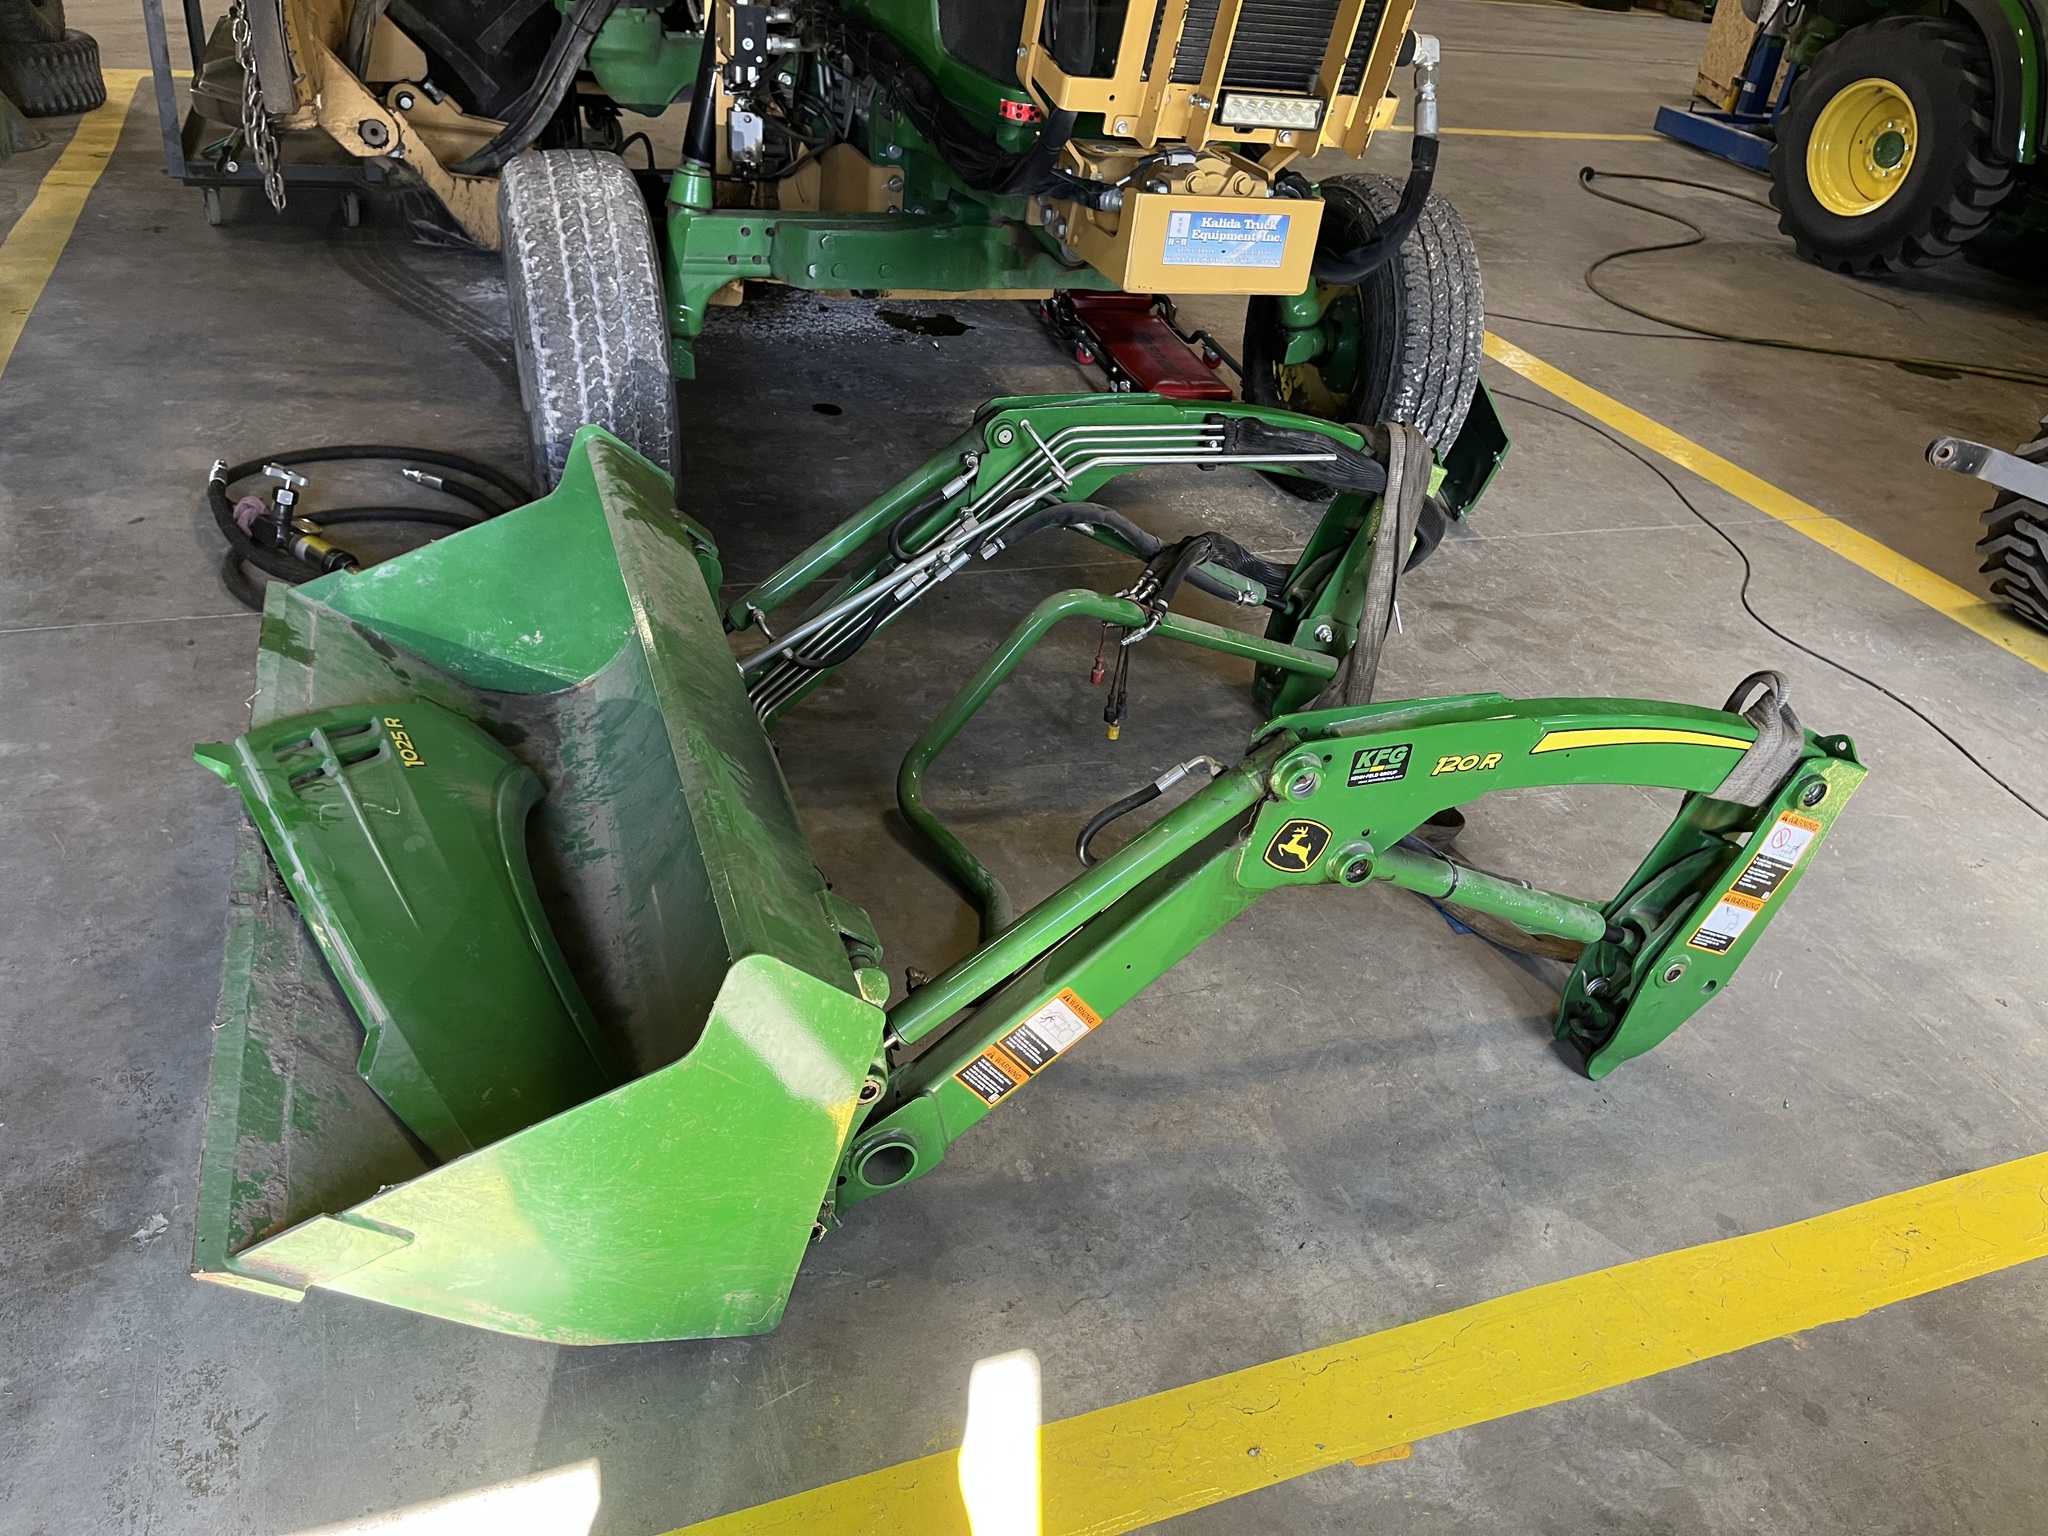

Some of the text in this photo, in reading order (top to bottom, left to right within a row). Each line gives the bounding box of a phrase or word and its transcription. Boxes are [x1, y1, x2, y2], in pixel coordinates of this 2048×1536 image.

[1201, 217, 1277, 231] Kalida Truck
[1191, 229, 1282, 243] Equipment, Inc.
[1355, 745, 1409, 769] KFG
[1380, 769, 1398, 777] GROUP
[1788, 815, 1819, 832] WARNING
[1730, 896, 1760, 911] WARNING
[1069, 999, 1095, 1025] WARNING
[995, 1056, 1022, 1082] WARNING
